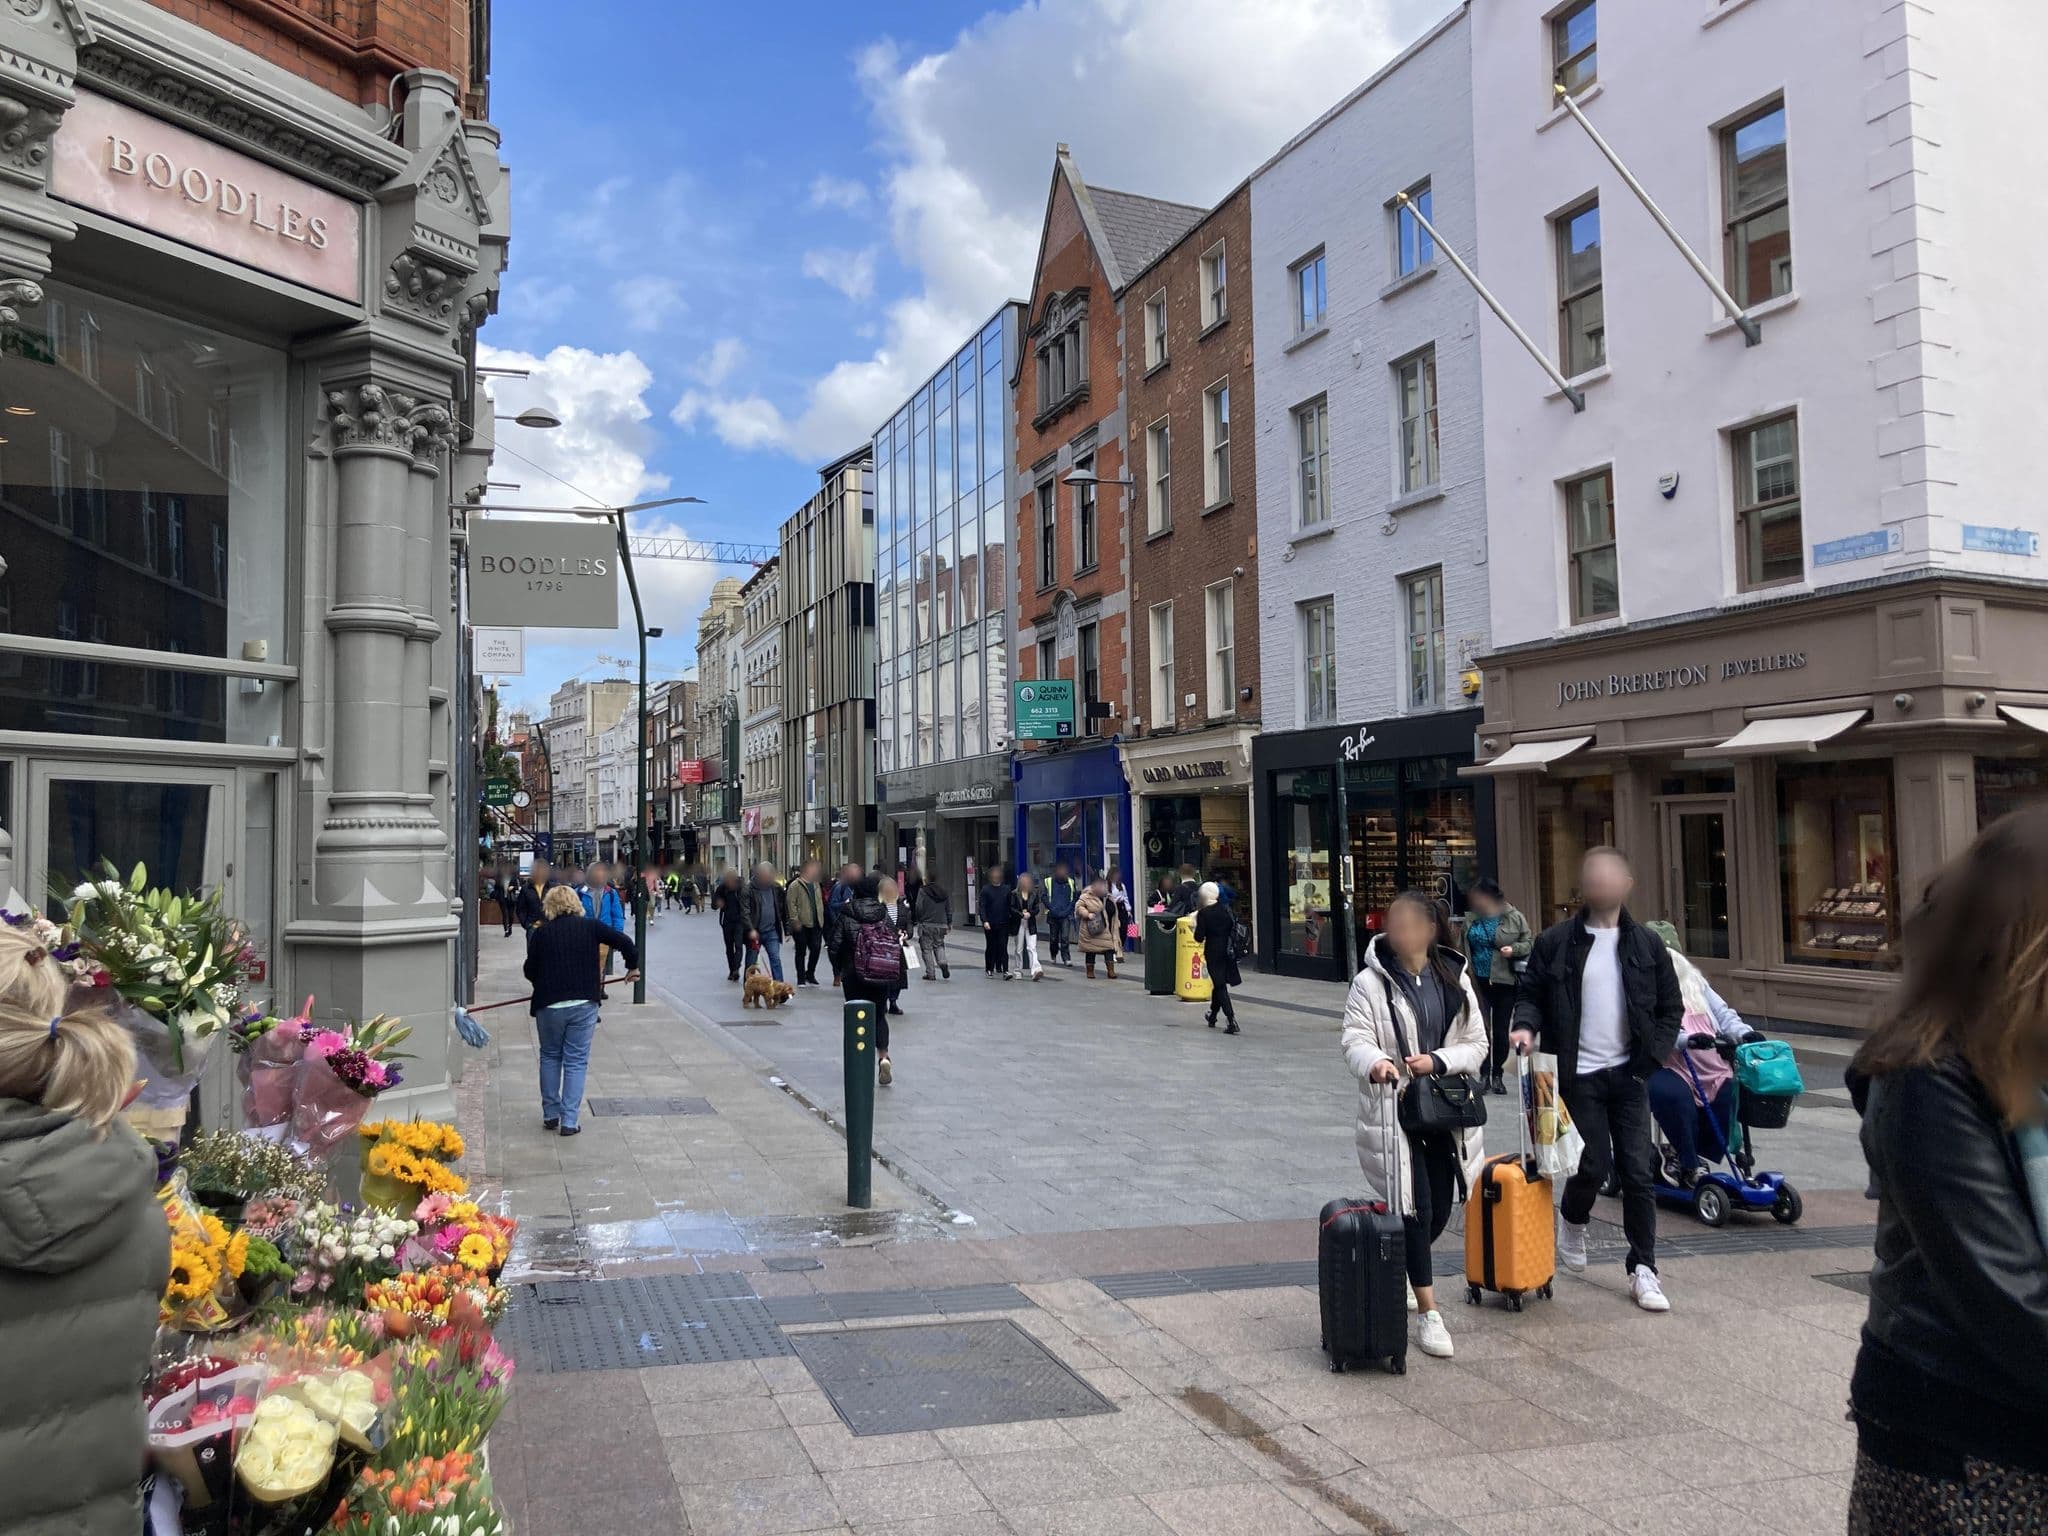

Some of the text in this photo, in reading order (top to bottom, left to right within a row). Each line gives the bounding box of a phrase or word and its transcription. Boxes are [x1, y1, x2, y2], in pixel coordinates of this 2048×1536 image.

[106, 135, 329, 249] BOODLES
[1891, 533, 1901, 546] 2
[480, 555, 607, 577] BOODLES
[527, 581, 563, 591] 1798
[1556, 652, 1807, 708] JOHN BRERETON JEWELLERS
[1142, 765, 1171, 784] CARD
